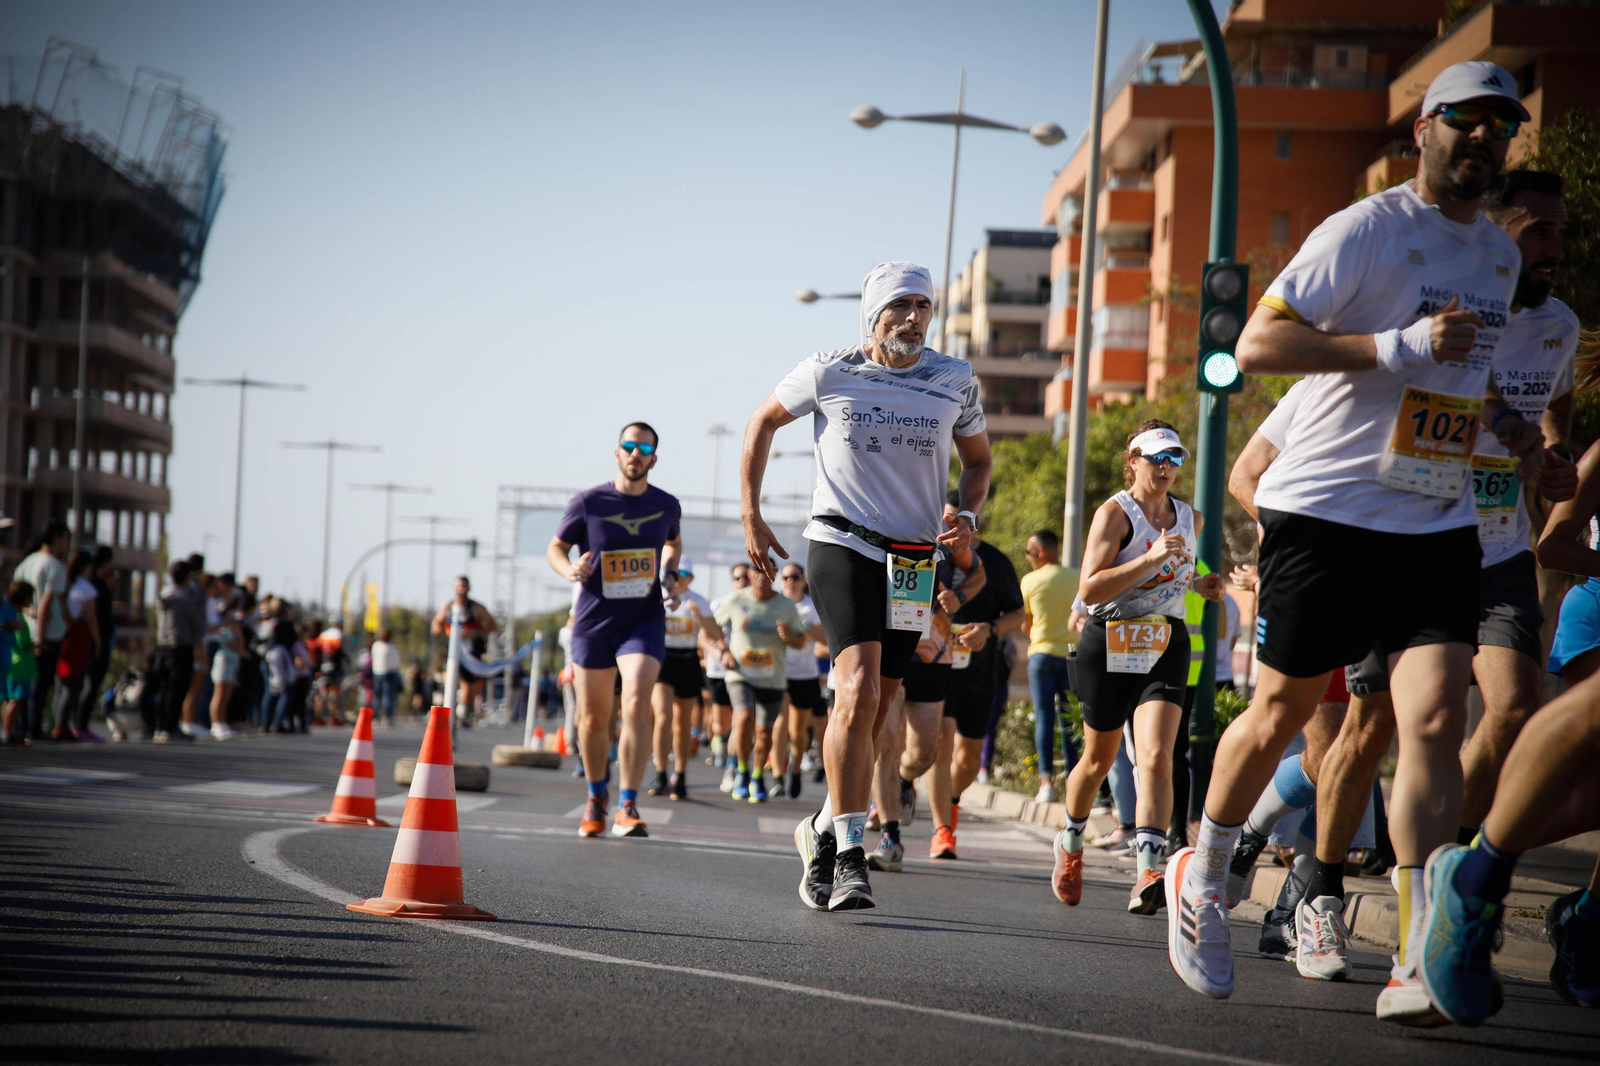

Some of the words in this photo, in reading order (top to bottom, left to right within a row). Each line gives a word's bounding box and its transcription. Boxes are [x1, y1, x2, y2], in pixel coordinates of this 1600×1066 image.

[1419, 284, 1457, 301] Medi
[1507, 369, 1556, 380] Maratón
[1521, 381, 1551, 396] 2024
[842, 407, 872, 422] San
[875, 410, 940, 429] Silvestre
[1410, 407, 1477, 444] 1021
[891, 433, 903, 445] el
[906, 436, 936, 452] ejido
[1413, 438, 1437, 450] PEPE
[919, 448, 934, 457] 2023
[608, 557, 650, 573] 1106
[1115, 624, 1166, 643] 1734
